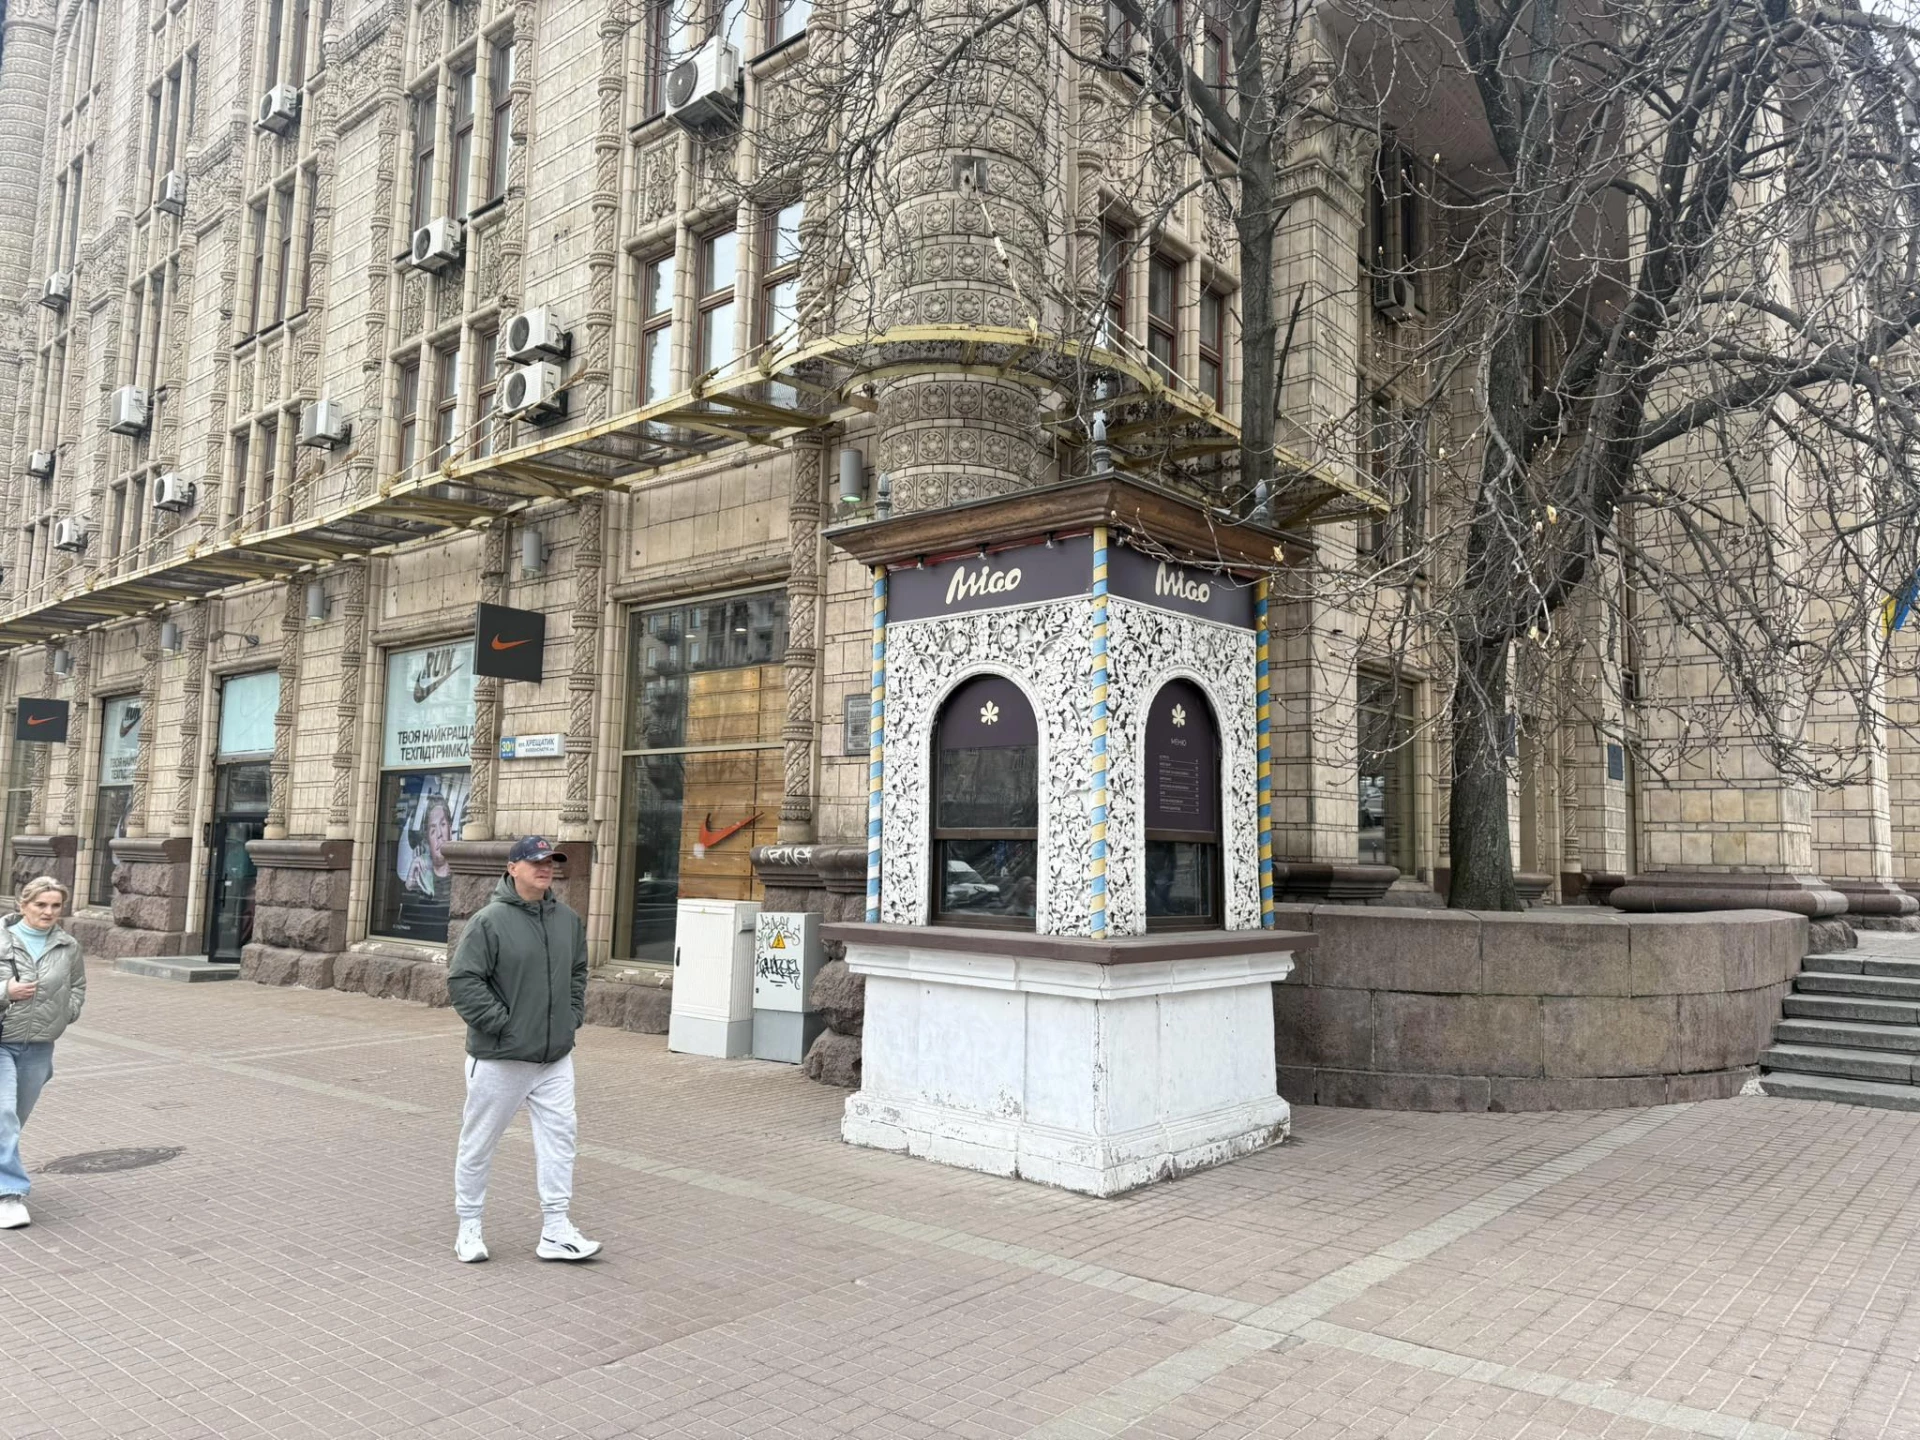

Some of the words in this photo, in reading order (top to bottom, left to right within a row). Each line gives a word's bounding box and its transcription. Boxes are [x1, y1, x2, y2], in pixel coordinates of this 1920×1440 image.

[421, 648, 455, 679] RUN
[398, 730, 421, 745] ТВОЯ
[422, 724, 475, 742] НАЙКРАЩА
[400, 743, 470, 762] ТЕХПІДТРИМКА
